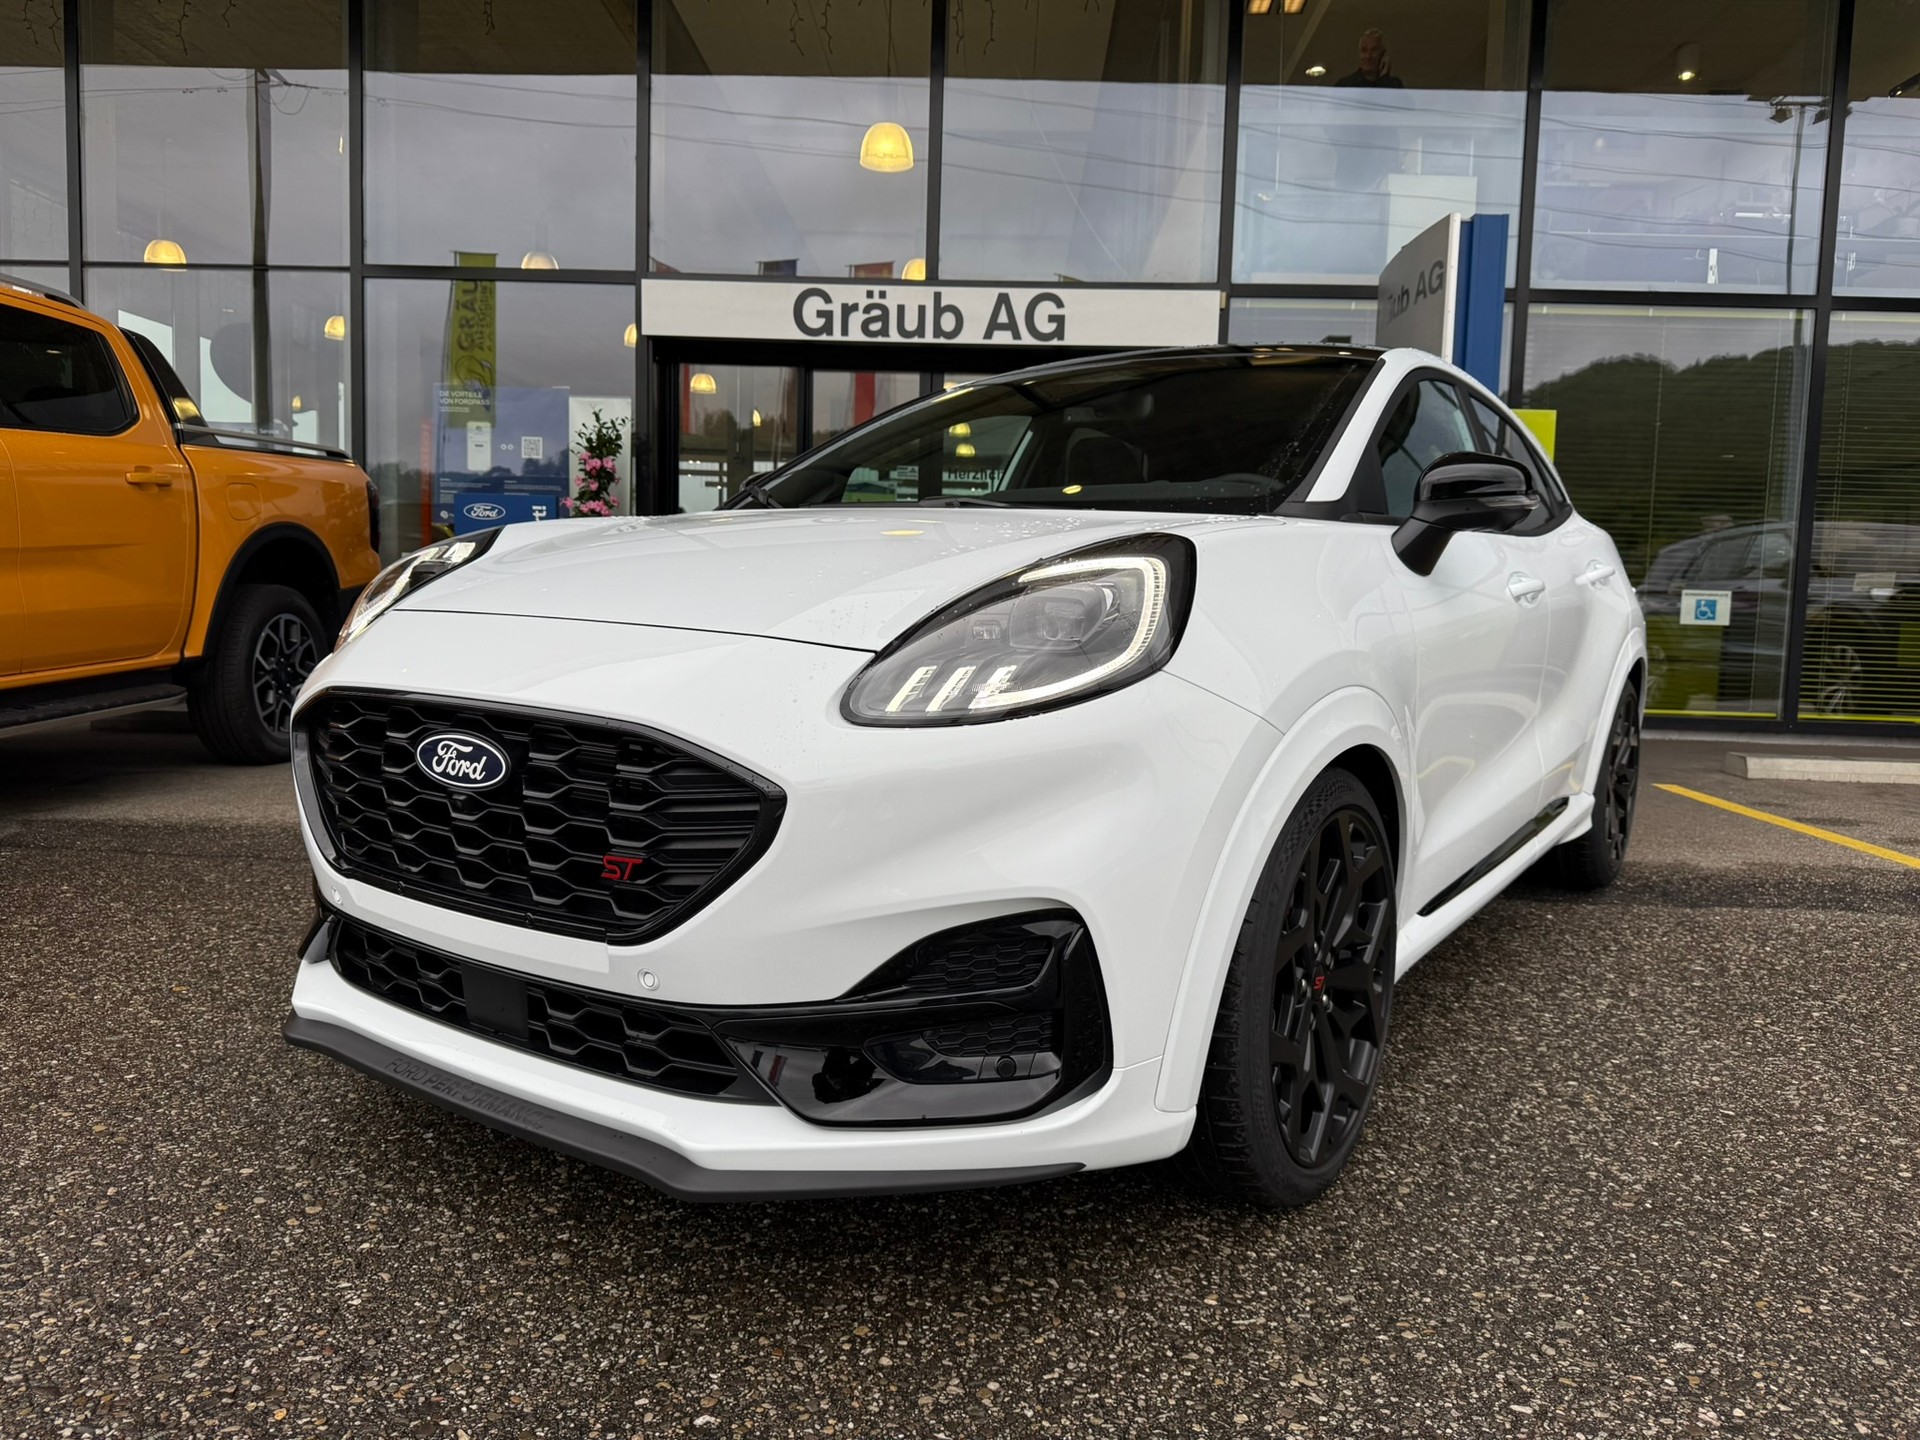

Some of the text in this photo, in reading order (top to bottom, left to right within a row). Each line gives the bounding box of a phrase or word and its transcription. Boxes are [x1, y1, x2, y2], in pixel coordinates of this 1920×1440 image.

[1414, 260, 1444, 305] AG
[456, 280, 478, 353] GRÄU
[793, 287, 1066, 342] Gräub AG
[470, 504, 499, 518] Ford
[432, 740, 487, 781] Ford
[601, 855, 643, 881] ST
[384, 1058, 555, 1131] FORD PERFORMANCE
